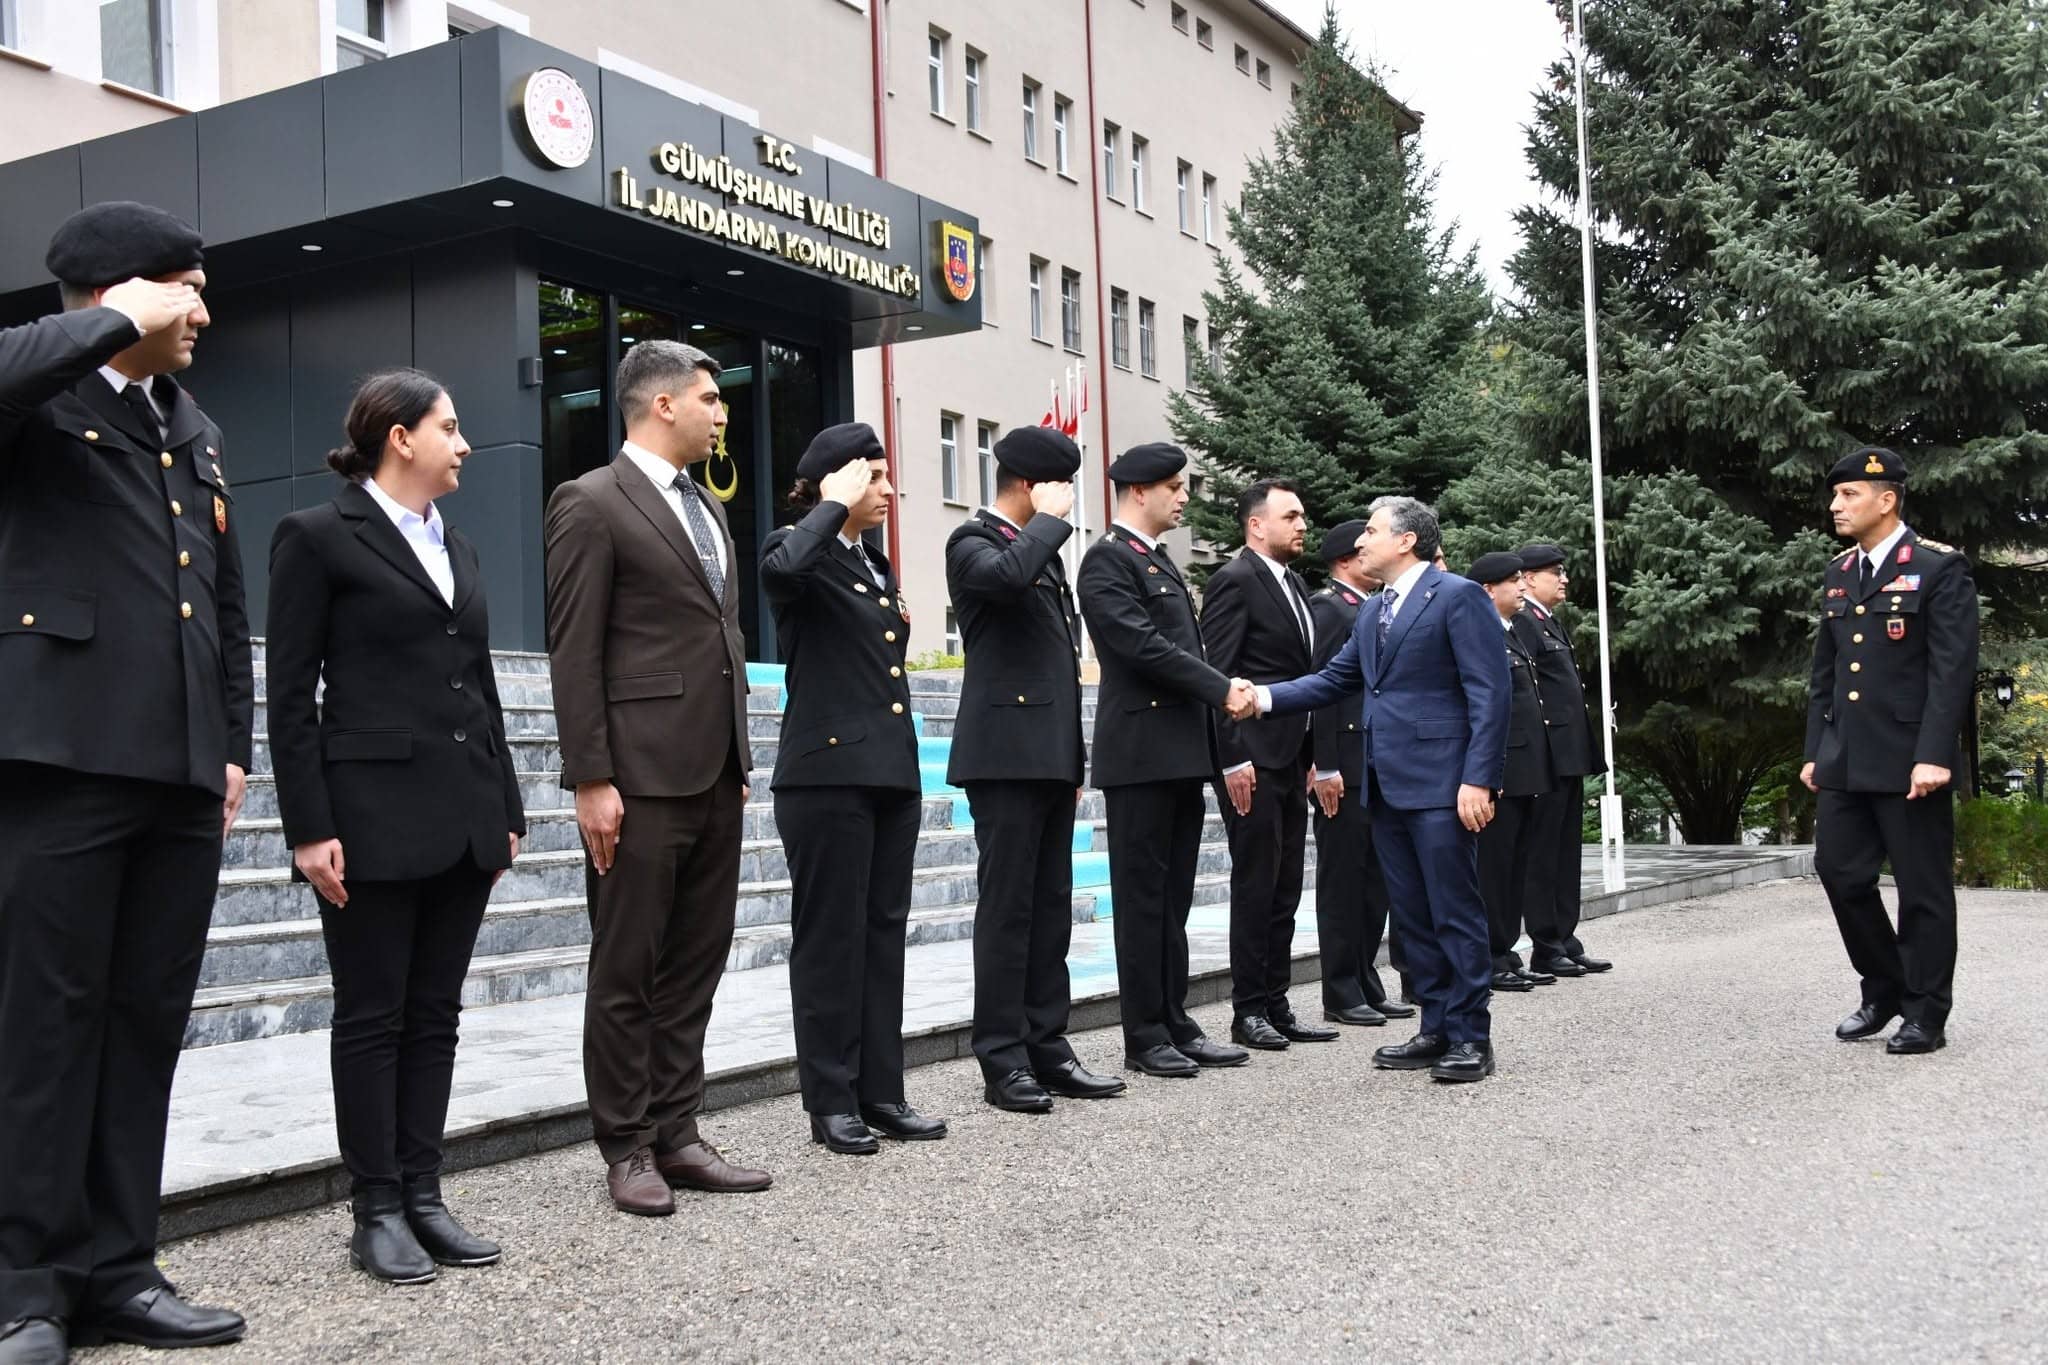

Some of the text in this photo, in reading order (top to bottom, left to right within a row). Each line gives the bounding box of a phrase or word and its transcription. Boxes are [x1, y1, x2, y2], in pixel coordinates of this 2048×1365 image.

[659, 142, 891, 250] GÜMÜŞHANE VALİLİĞİ
[762, 134, 803, 175] T.C.
[620, 166, 643, 210] İL
[648, 186, 781, 254] JANDARMA
